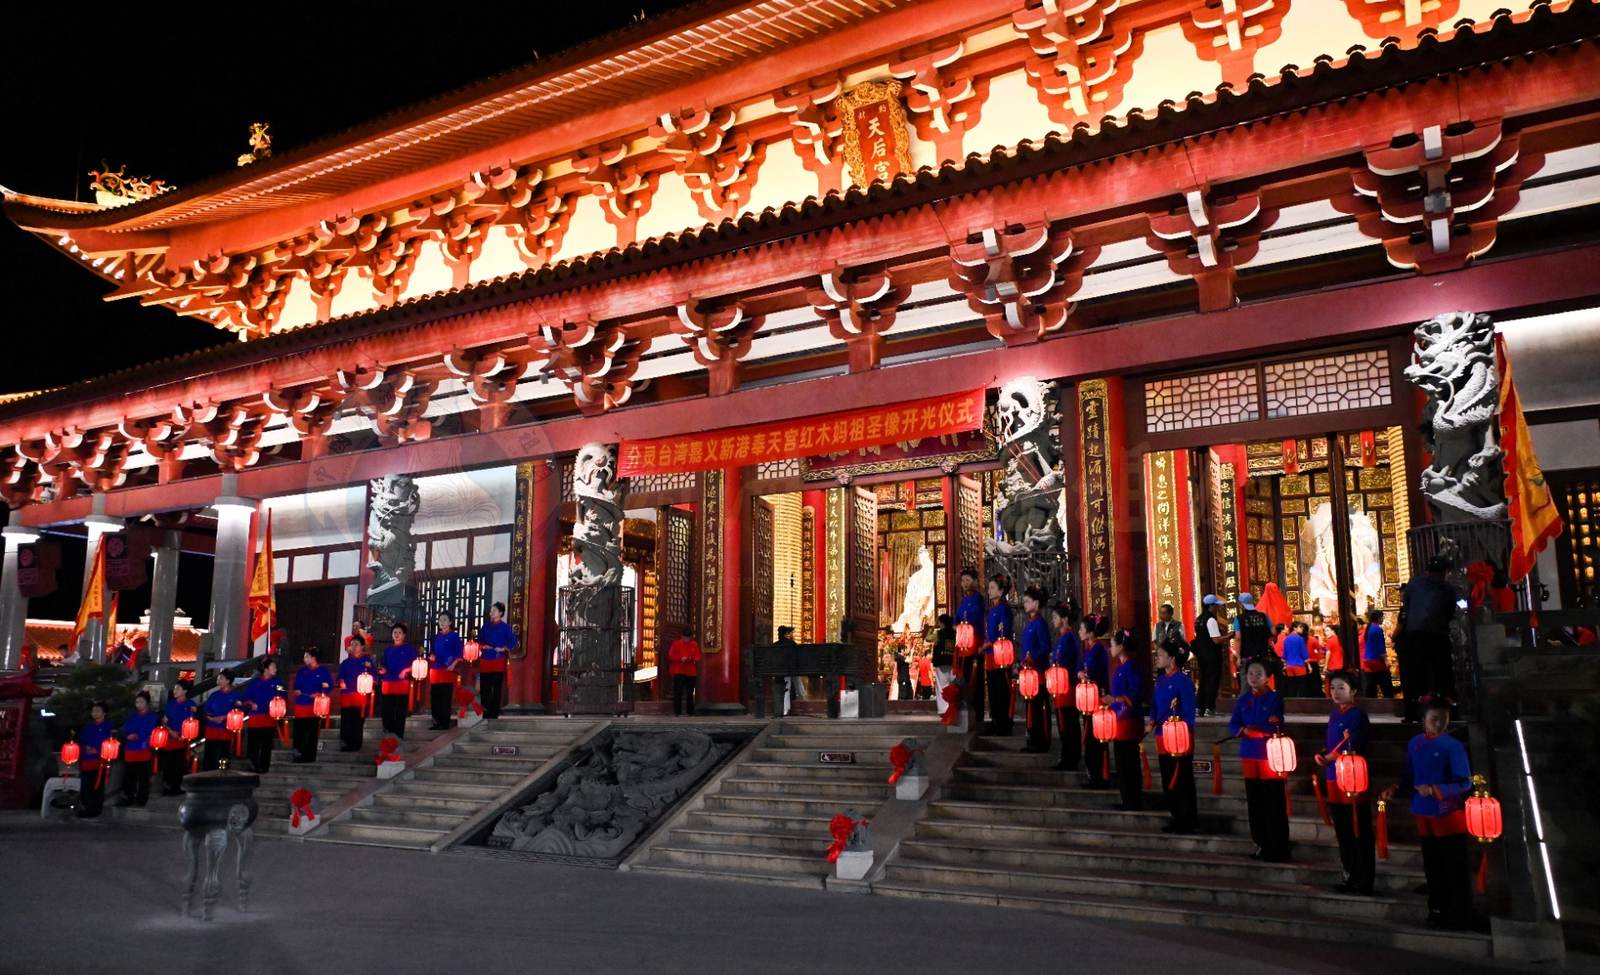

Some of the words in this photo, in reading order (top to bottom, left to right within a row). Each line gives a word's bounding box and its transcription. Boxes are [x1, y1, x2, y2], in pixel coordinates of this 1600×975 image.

[628, 398, 974, 467] 分灵台湾嘉义新港奉天宫红木妈祖圣像开光仪式
